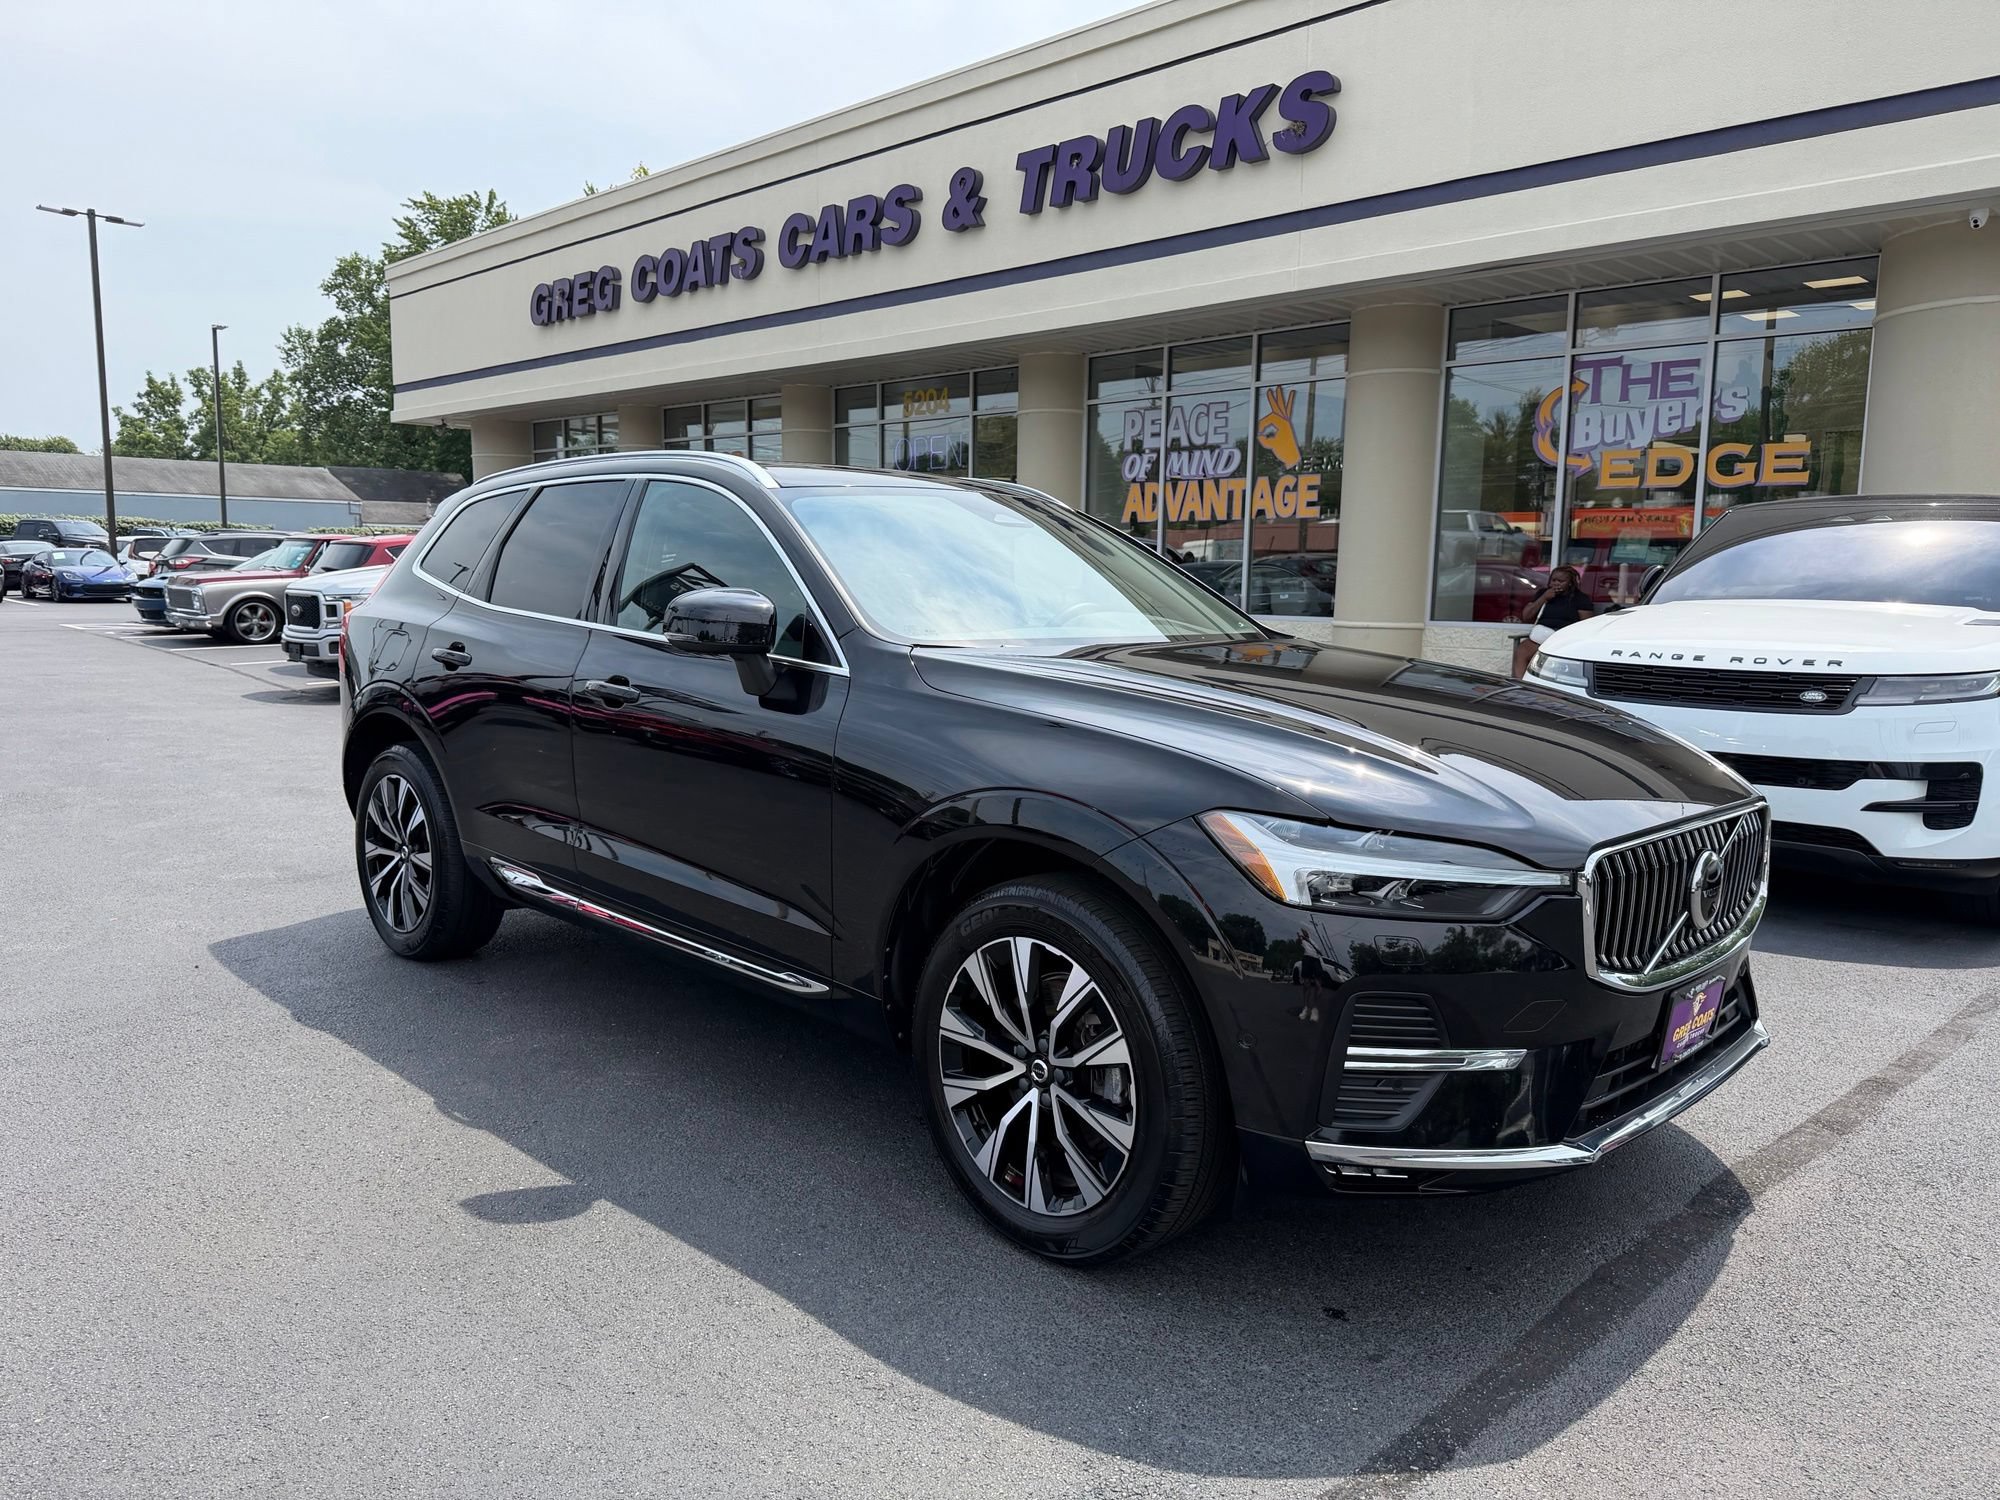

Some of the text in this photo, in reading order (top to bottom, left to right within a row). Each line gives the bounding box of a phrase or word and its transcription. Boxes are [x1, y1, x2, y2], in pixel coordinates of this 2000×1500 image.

[530, 70, 1341, 326] GREG COATS CARS & TRUCKS
[902, 386, 950, 418] 5204
[1572, 355, 1702, 405] THE
[1122, 400, 1231, 450] PEACE
[895, 432, 968, 472] OPEN
[1121, 448, 1242, 482] OF MIND
[1597, 440, 1812, 489] EDGE
[1120, 473, 1322, 524] ADVANTAGE
[1610, 649, 1844, 668] RANGE ROVER
